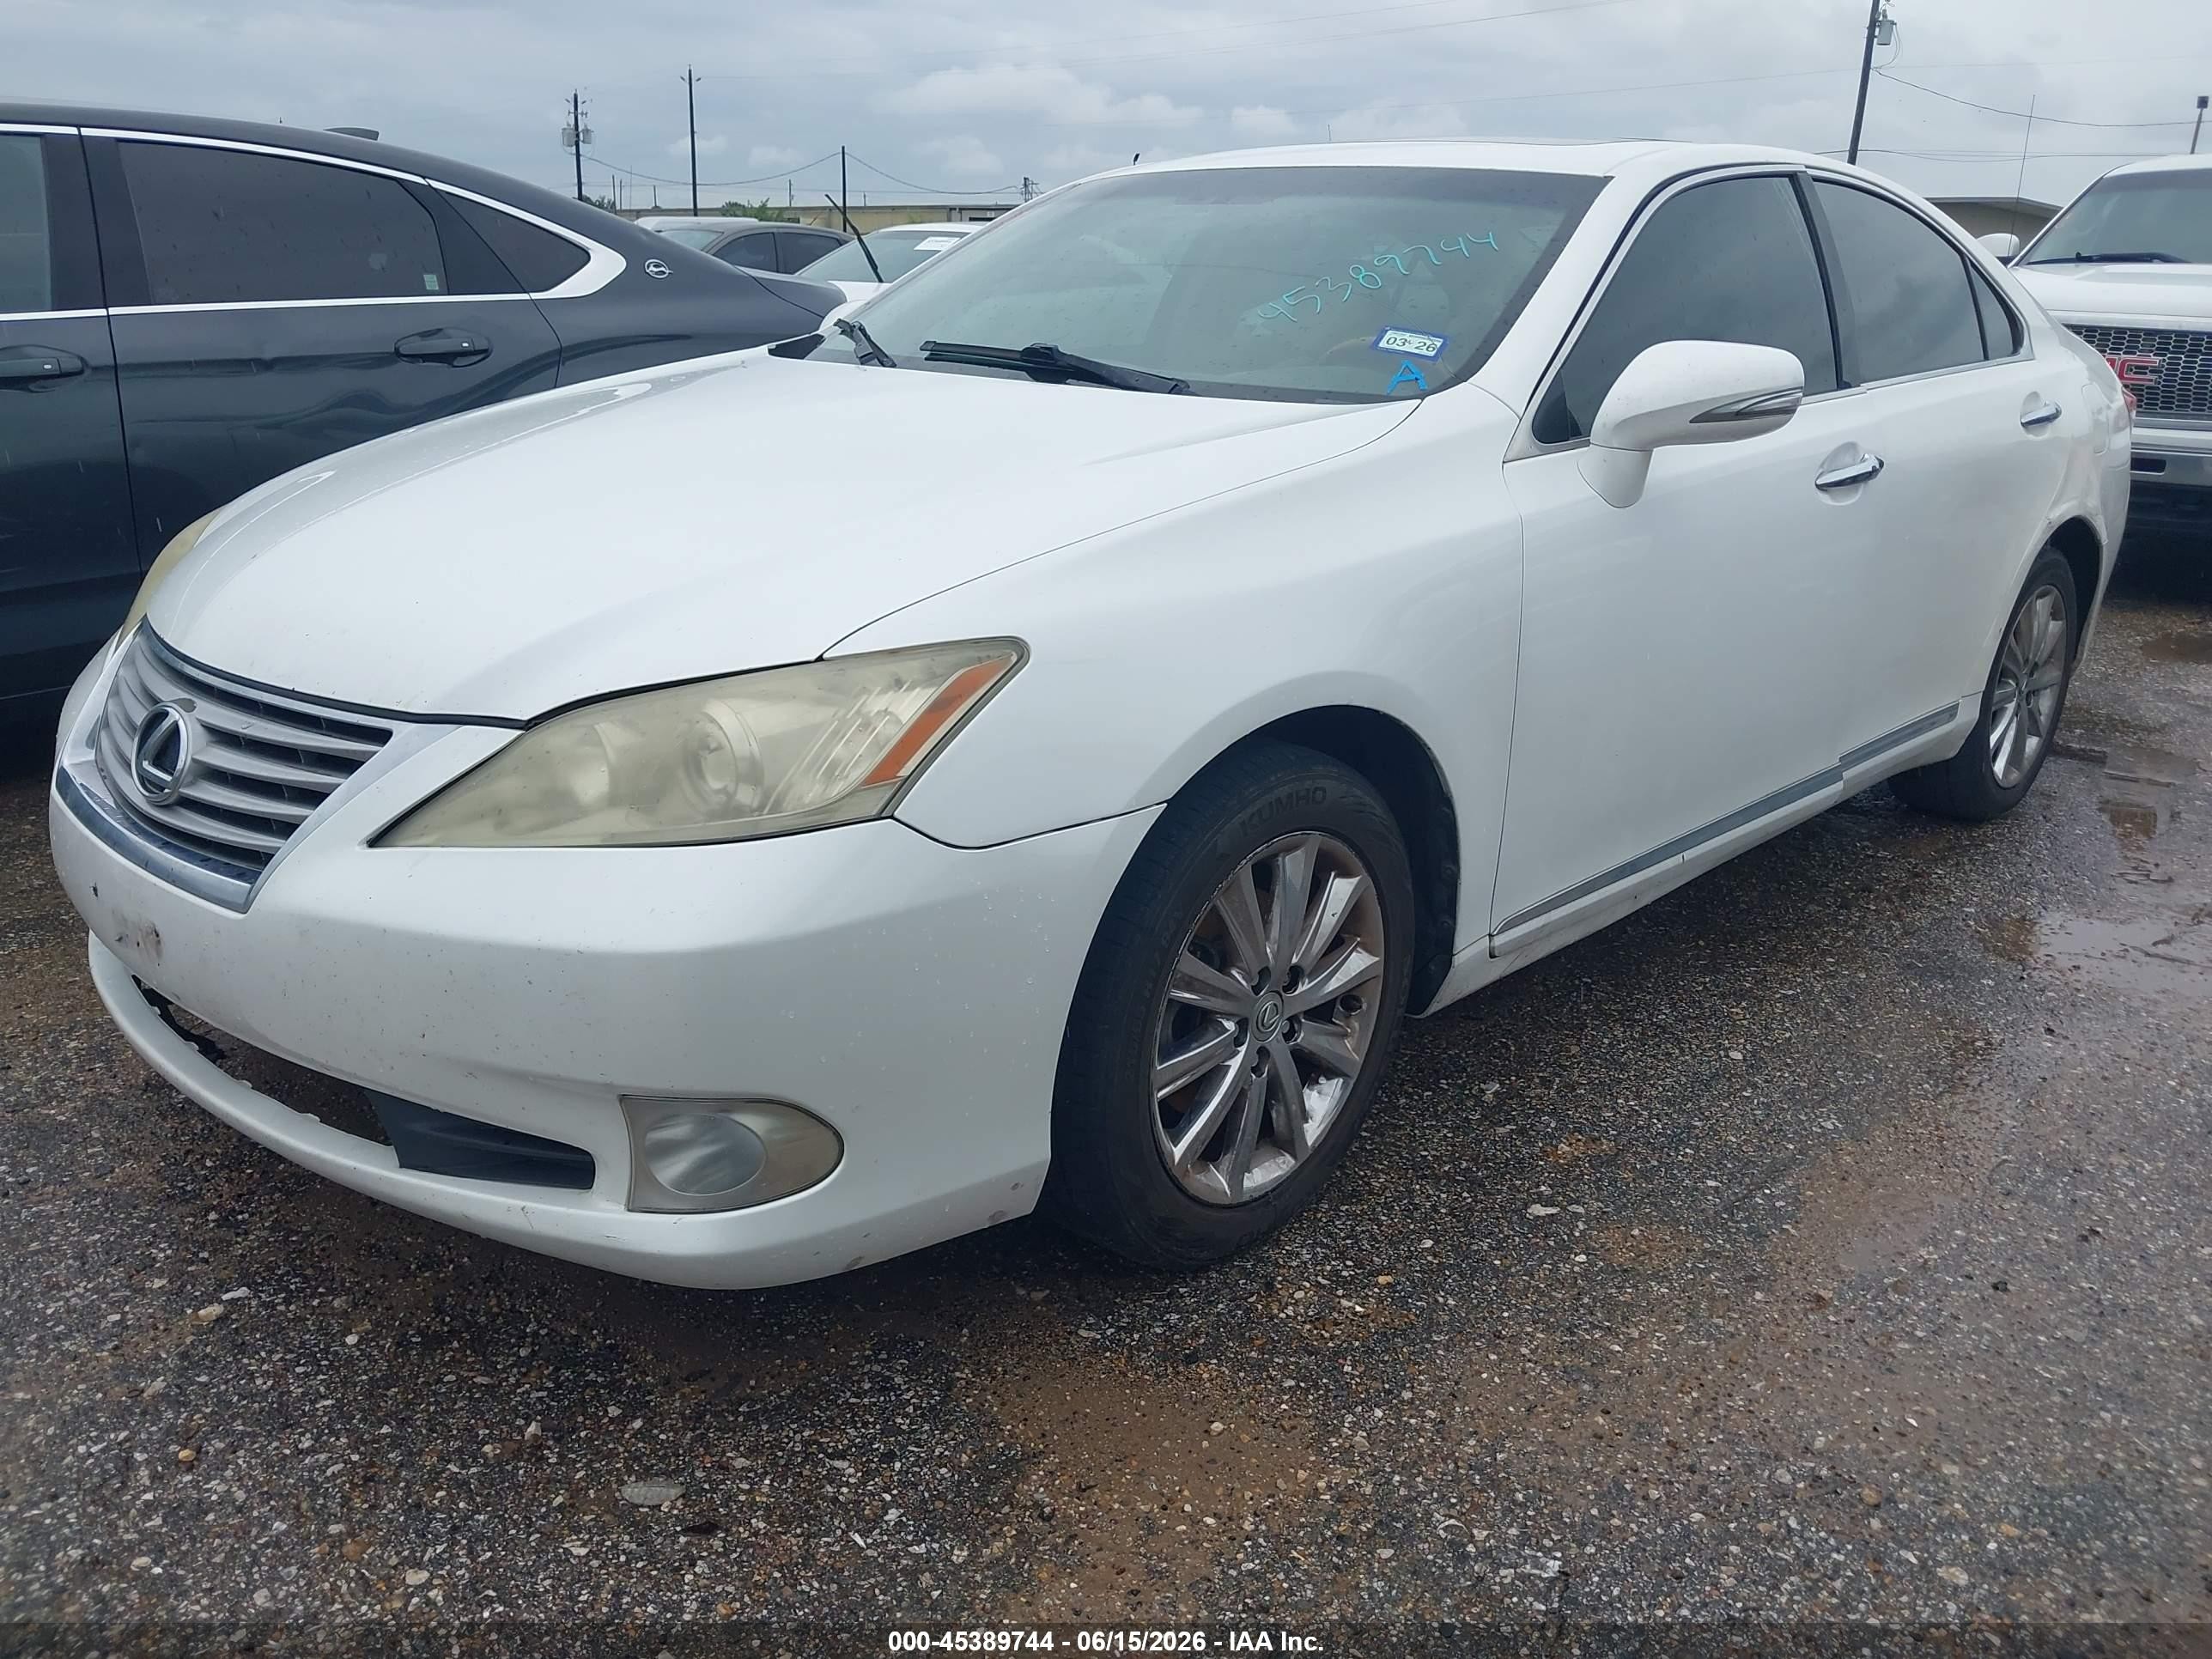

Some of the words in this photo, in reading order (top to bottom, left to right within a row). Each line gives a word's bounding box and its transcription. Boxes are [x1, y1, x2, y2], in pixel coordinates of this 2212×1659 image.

[1258, 232, 1499, 322] 45389744
[1387, 360, 1428, 395] A
[1239, 786, 1328, 836] KUMHO
